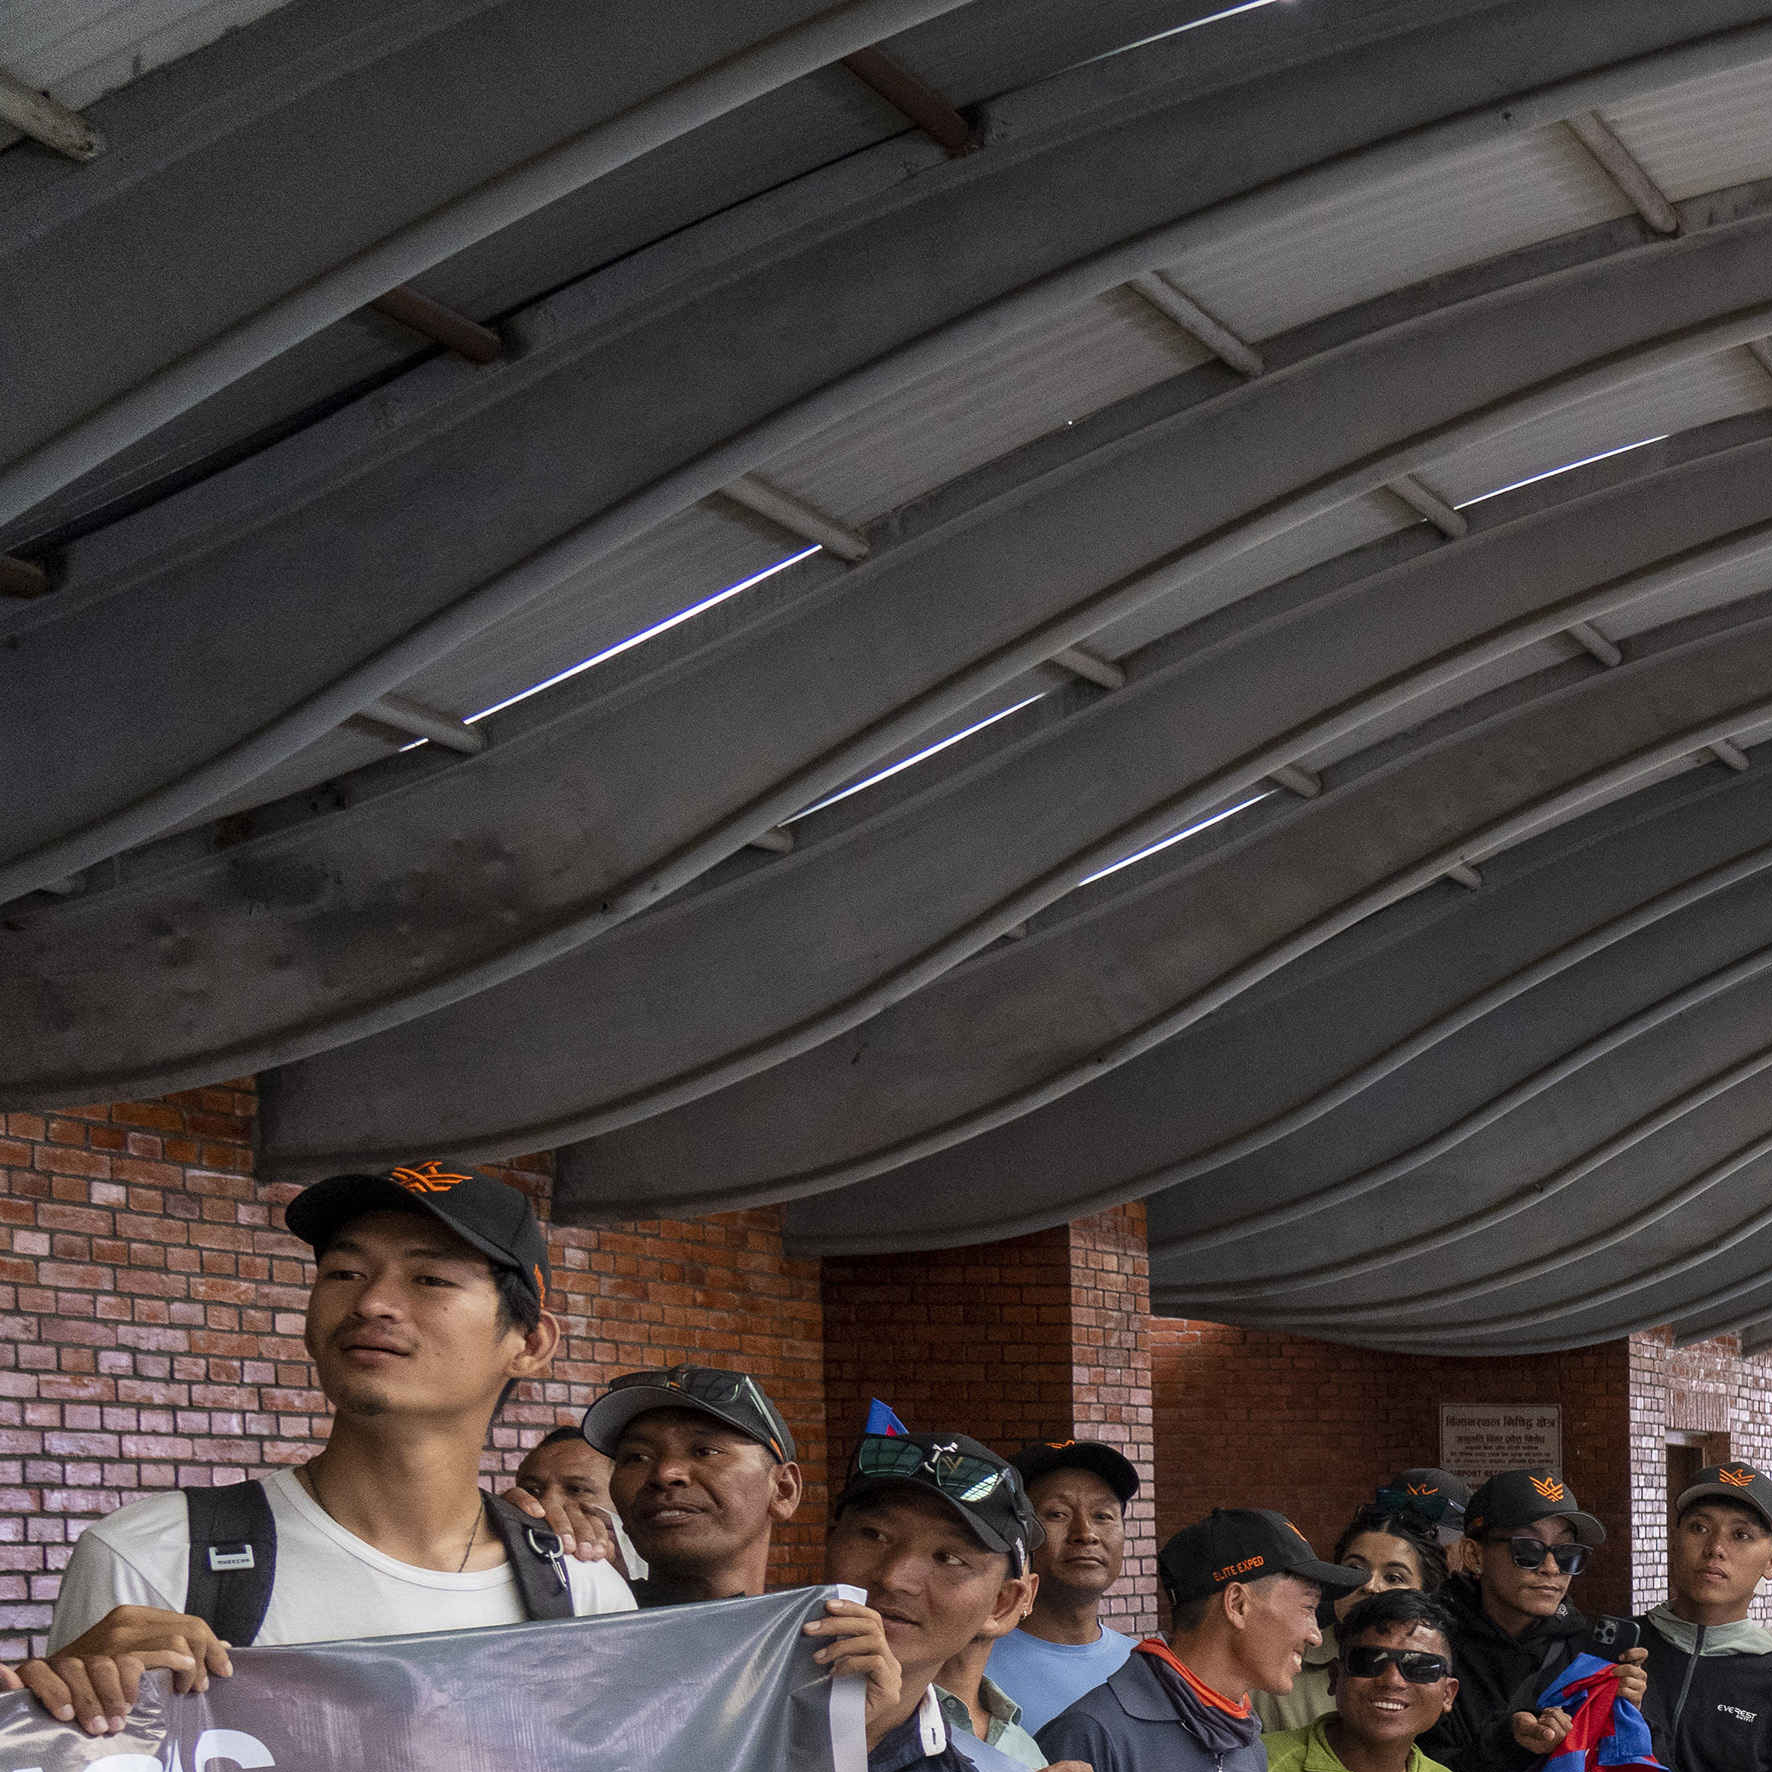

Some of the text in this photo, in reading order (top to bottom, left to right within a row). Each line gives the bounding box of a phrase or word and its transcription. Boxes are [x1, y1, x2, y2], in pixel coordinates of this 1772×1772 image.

[1213, 1556, 1264, 1581] ELITE EXPED
[1717, 1704, 1757, 1720] EVEREST
